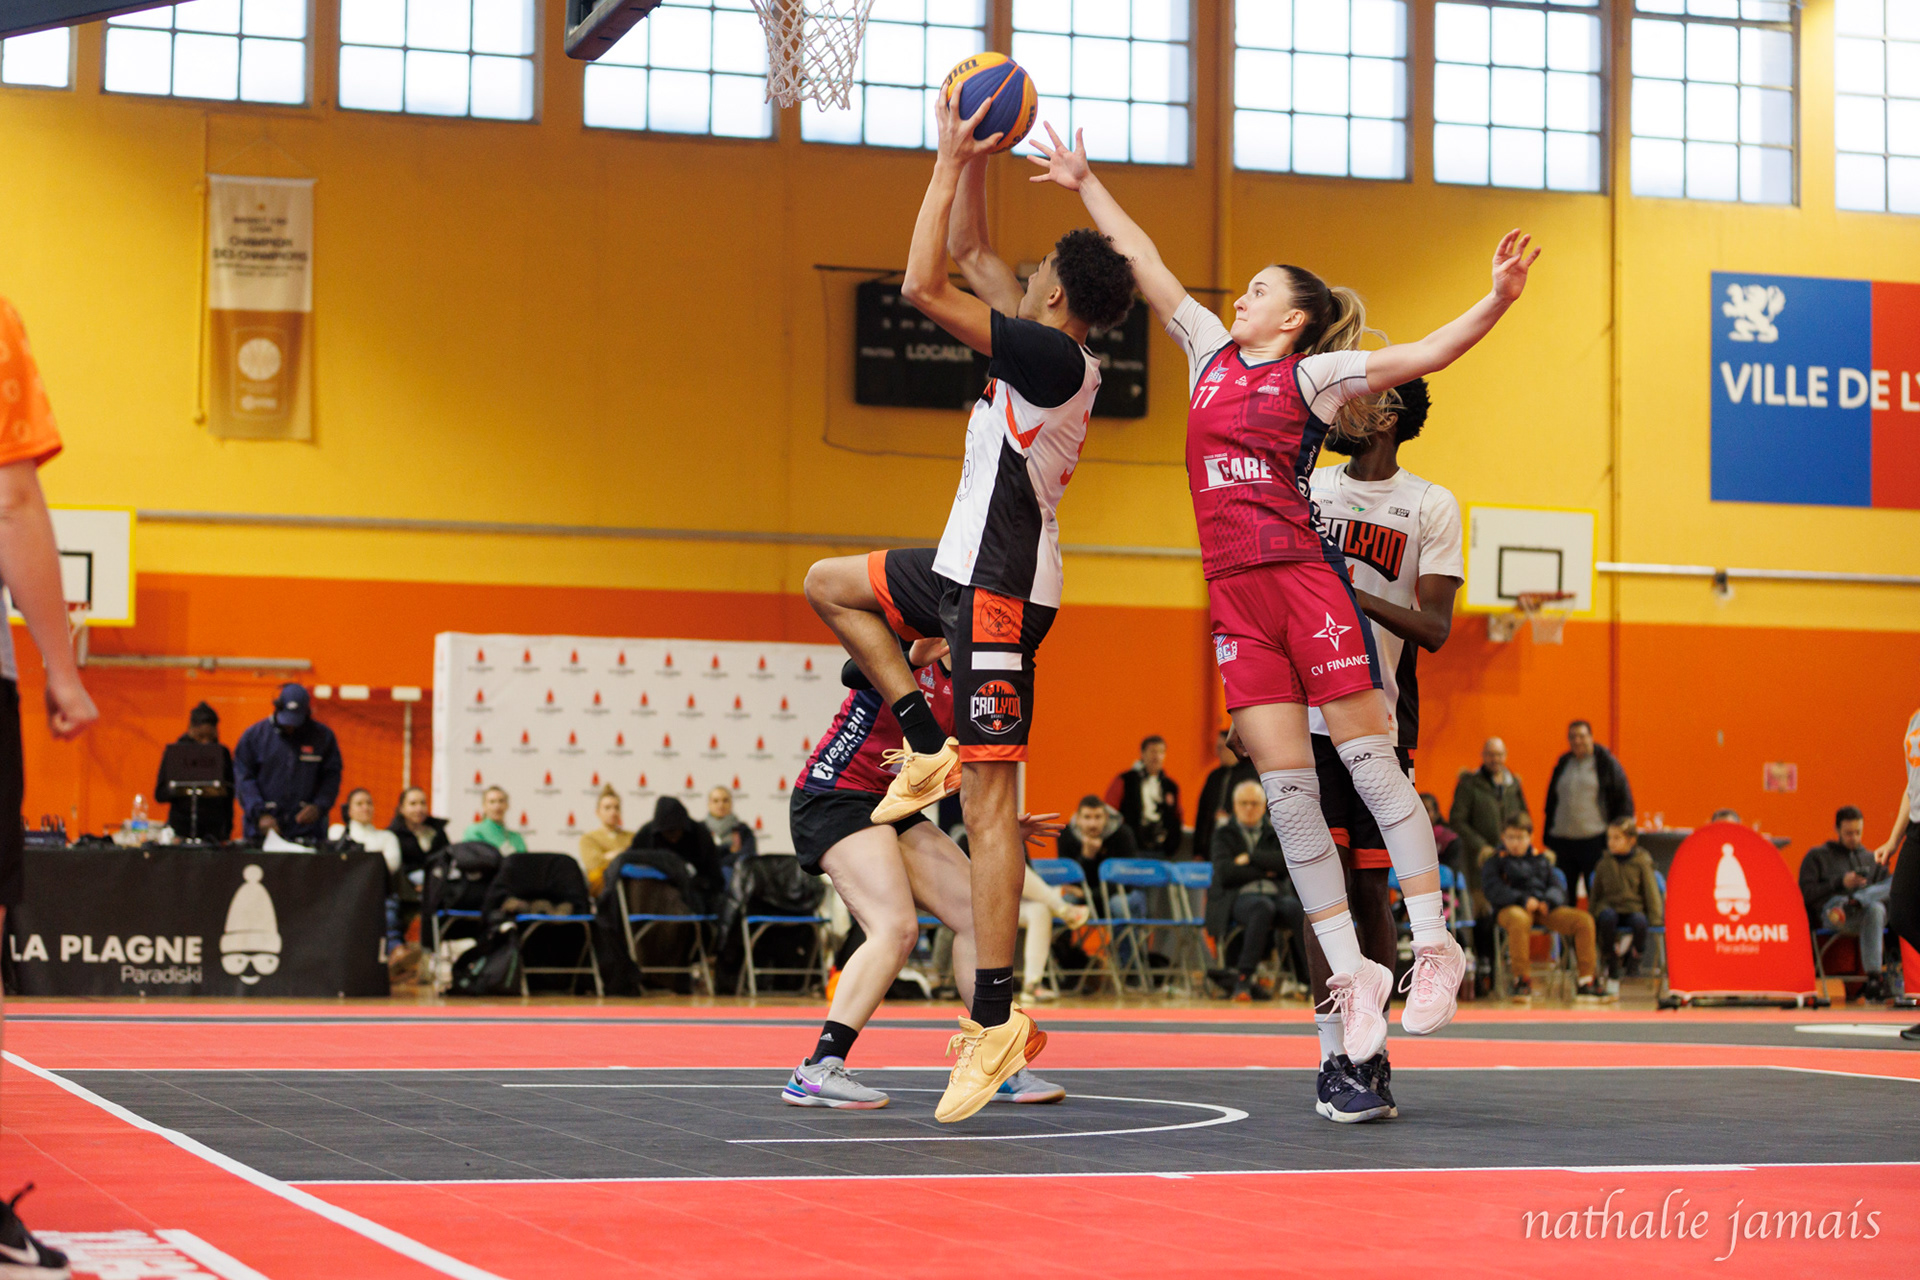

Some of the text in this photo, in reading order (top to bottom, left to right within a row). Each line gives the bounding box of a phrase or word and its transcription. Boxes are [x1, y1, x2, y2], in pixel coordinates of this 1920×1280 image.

[905, 343, 974, 363] LOCAUX
[1720, 361, 1829, 408] VILLE
[1838, 367, 1890, 411] DE
[1217, 456, 1272, 482] CARE
[1311, 654, 1371, 676] CV FINANCE
[972, 696, 1021, 719] CROLYON
[1684, 922, 1789, 943] LA PLAGNE
[9, 934, 203, 964] LA PLAGNE
[120, 965, 204, 984] Paradiski
